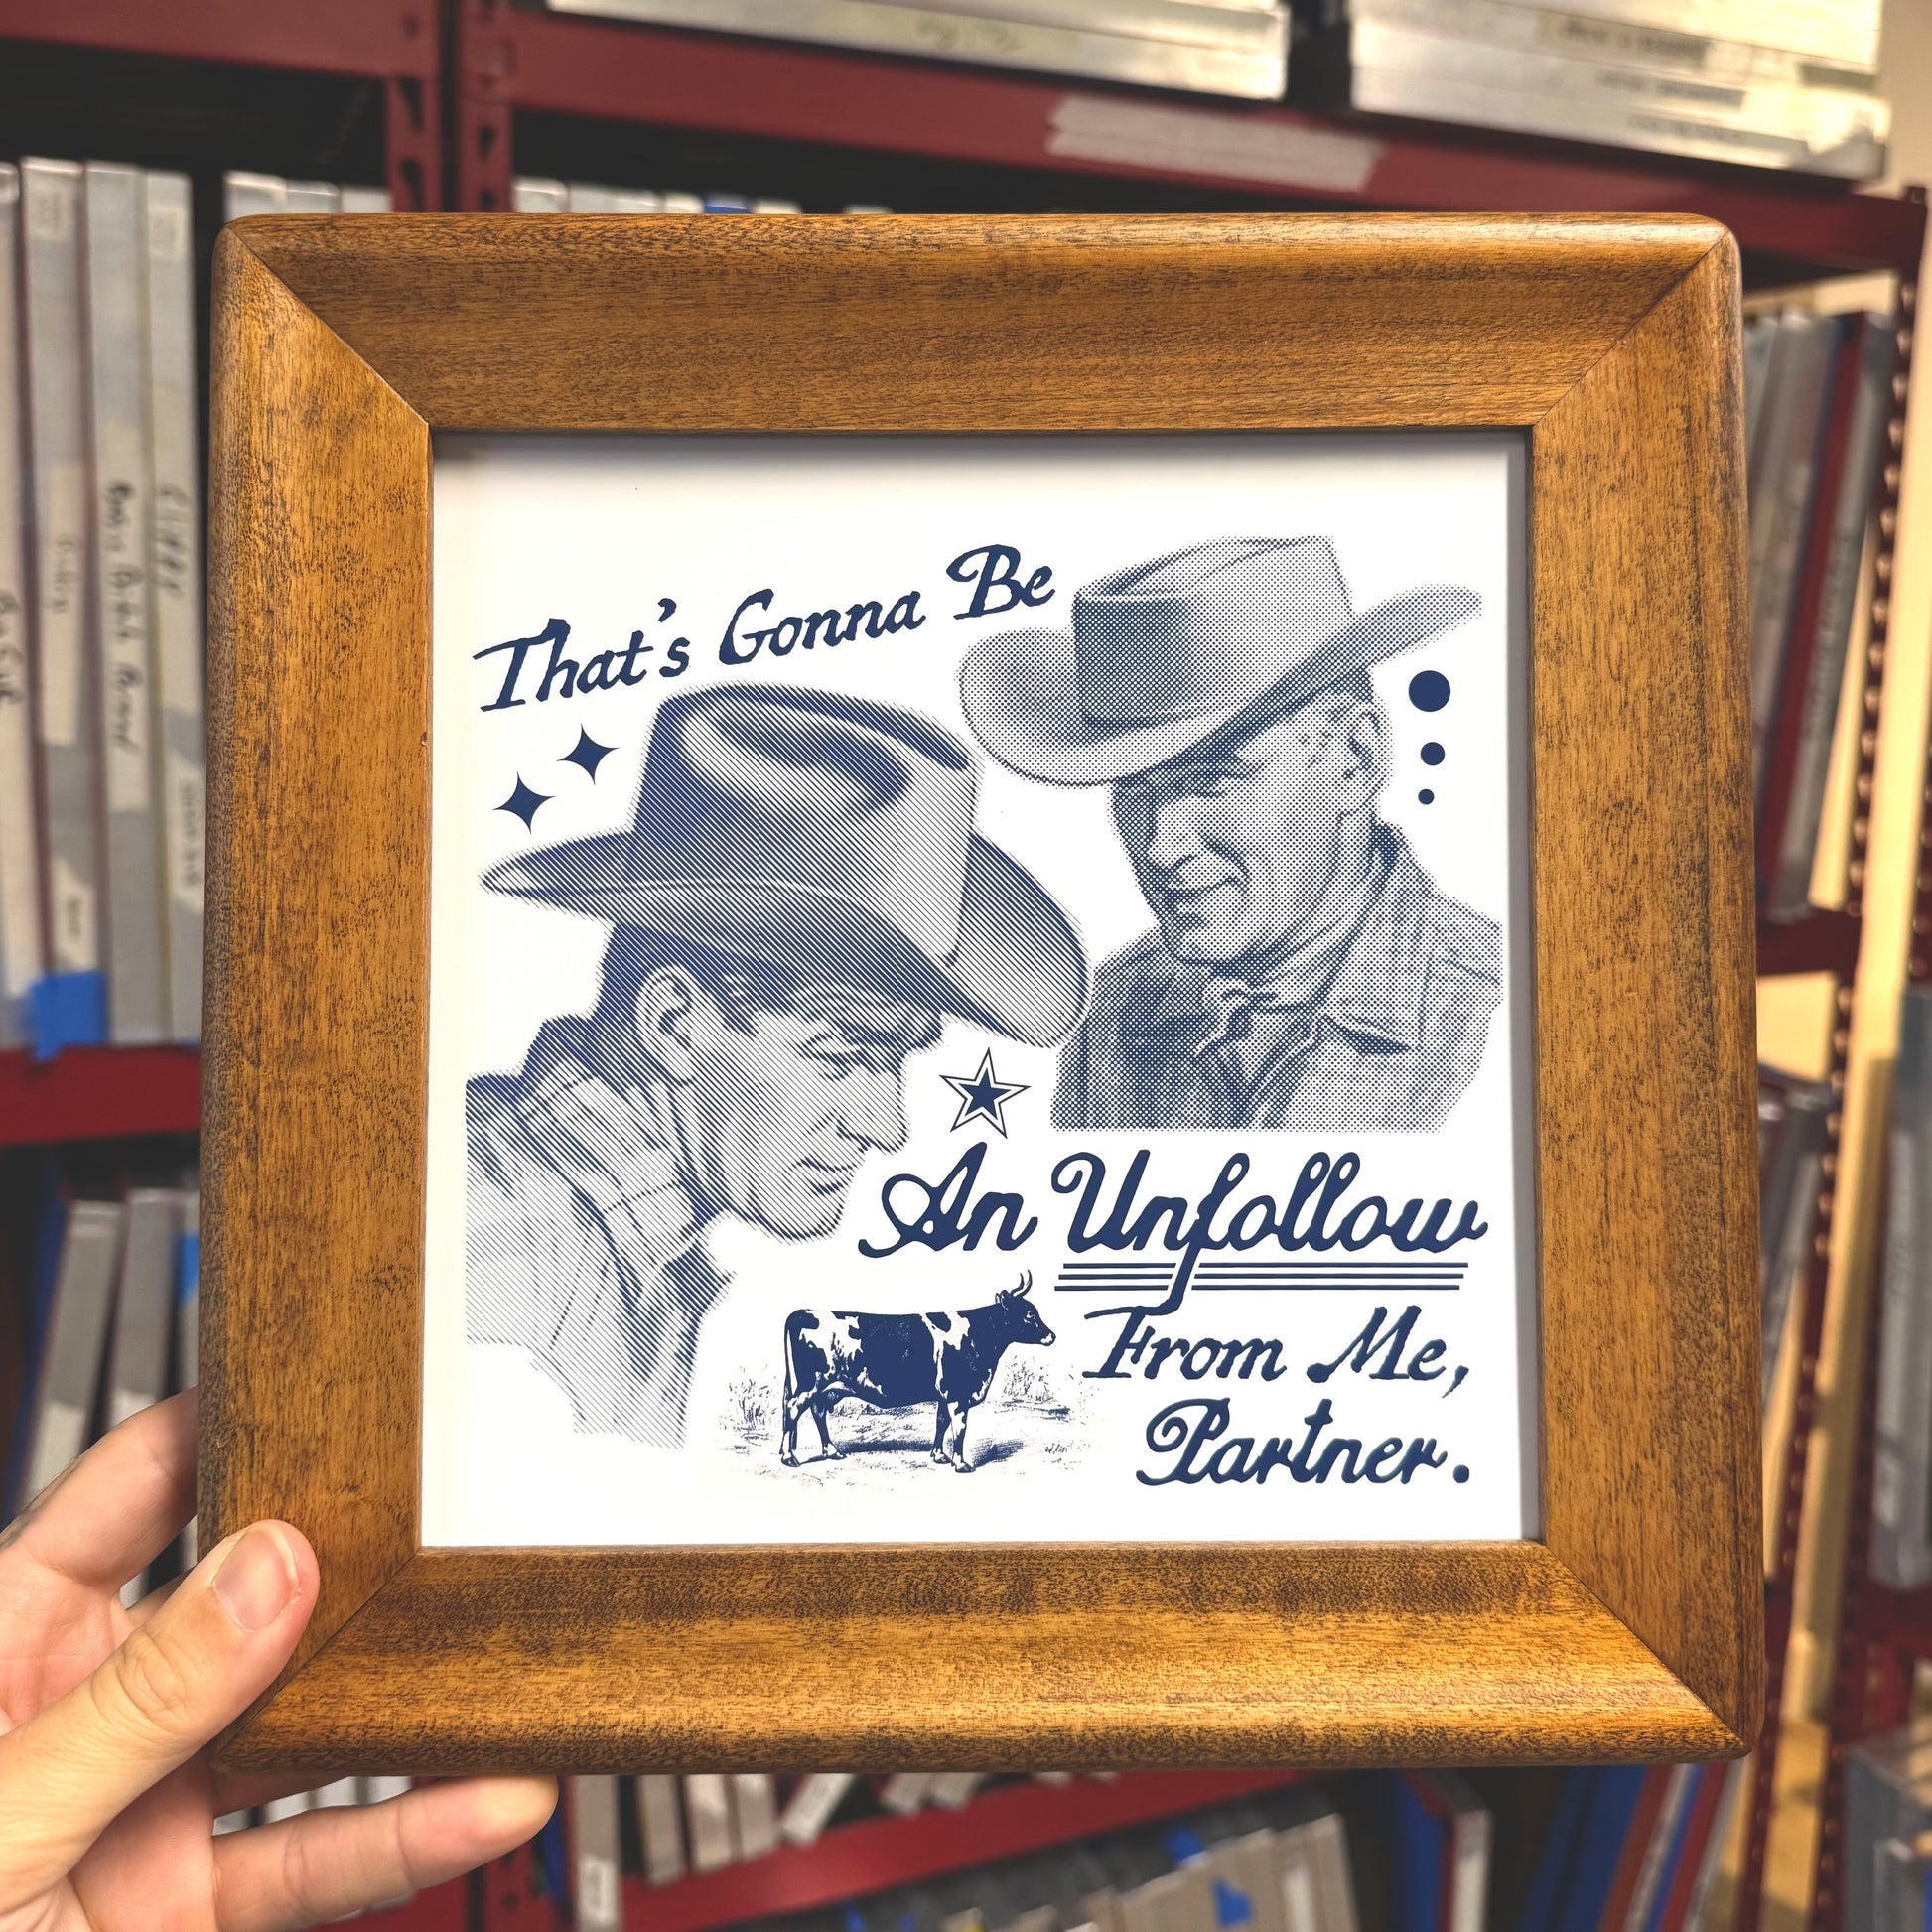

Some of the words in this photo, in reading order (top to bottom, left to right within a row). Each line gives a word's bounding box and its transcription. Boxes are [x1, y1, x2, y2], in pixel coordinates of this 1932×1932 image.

[472, 597, 692, 713] That's
[718, 588, 927, 666] Gonna
[945, 543, 1056, 621] Be
[857, 1141, 1039, 1259] An
[1050, 1149, 1489, 1303] Unfollow
[1081, 1306, 1288, 1382] From
[1306, 1305, 1469, 1399] Me,
[1135, 1397, 1470, 1487] Partner.
